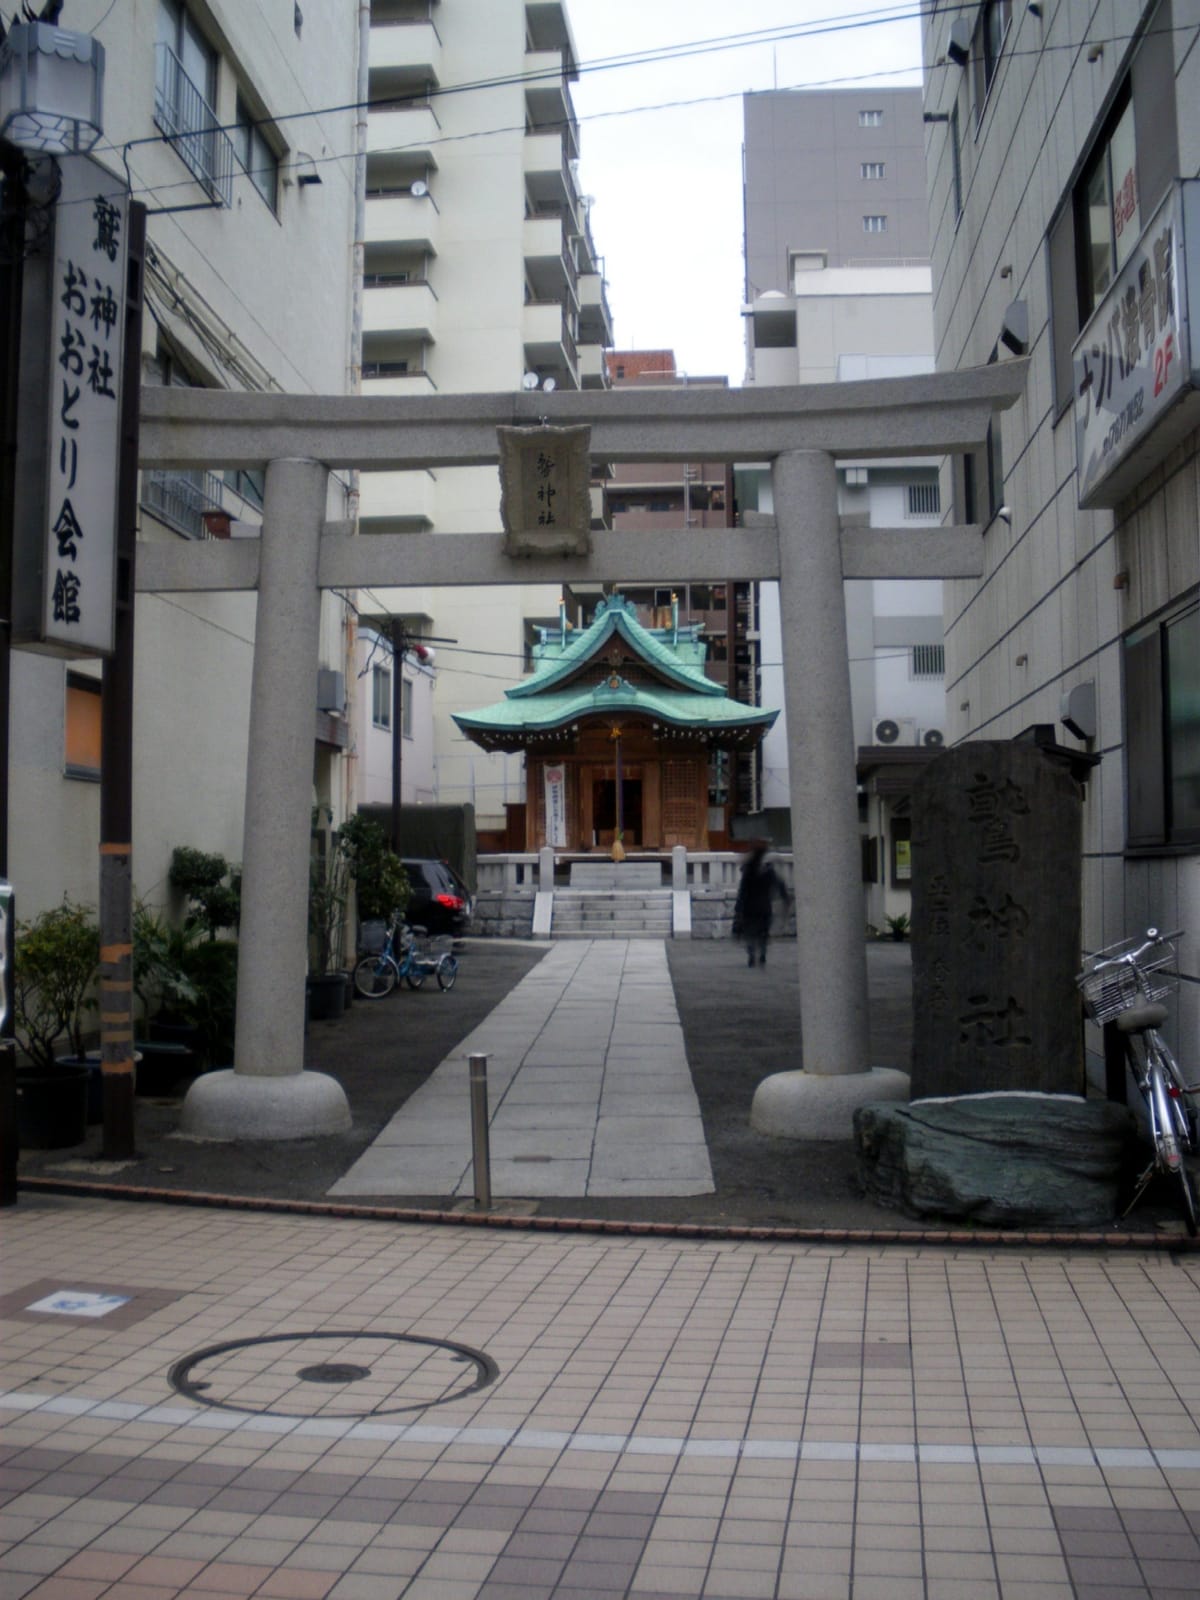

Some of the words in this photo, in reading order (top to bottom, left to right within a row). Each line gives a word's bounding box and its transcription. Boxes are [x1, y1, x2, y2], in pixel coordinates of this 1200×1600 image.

[88, 194, 121, 399] 鷲神社
[1154, 333, 1173, 397] 2F
[52, 260, 88, 624] おおとり会館
